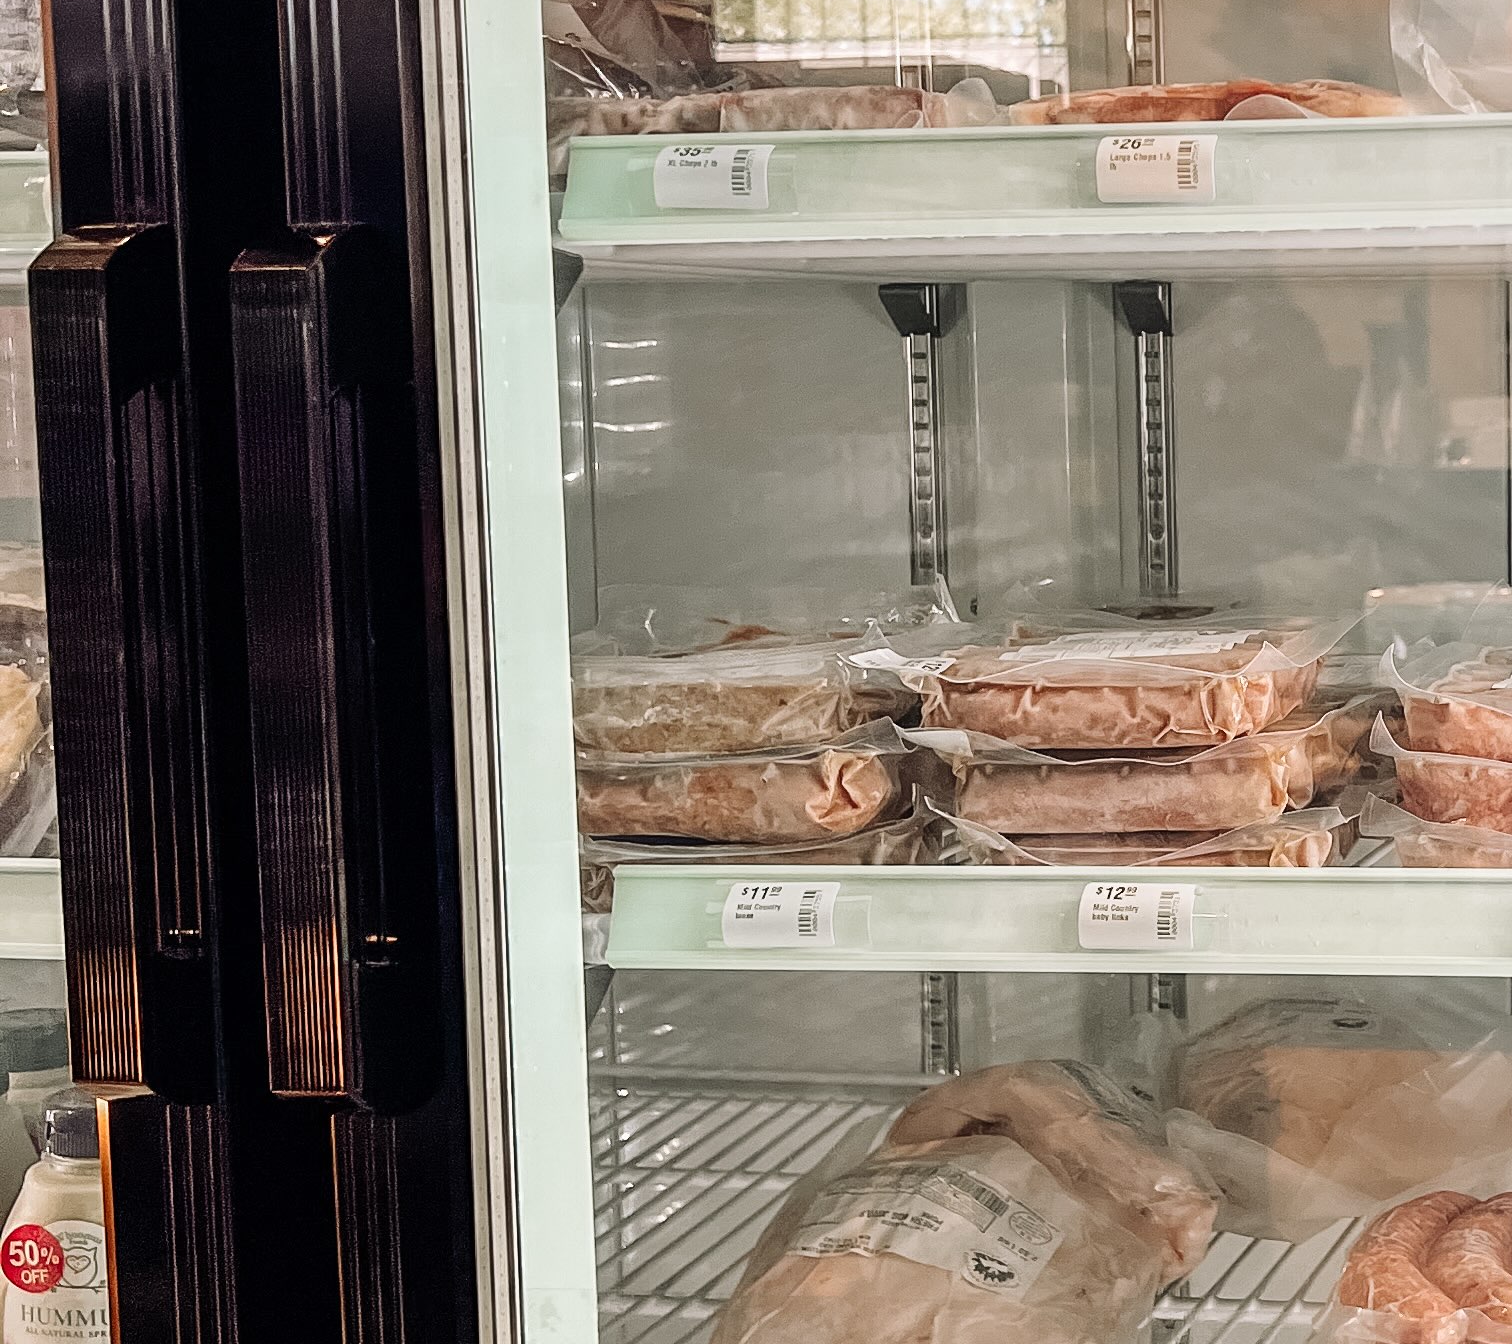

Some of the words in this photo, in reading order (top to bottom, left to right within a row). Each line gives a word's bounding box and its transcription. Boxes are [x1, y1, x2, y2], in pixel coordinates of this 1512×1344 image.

[9, 1240, 60, 1267] 50%
[21, 1268, 49, 1285] OFF
[25, 1326, 38, 1336] ALL
[42, 1328, 84, 1338] NATURAL
